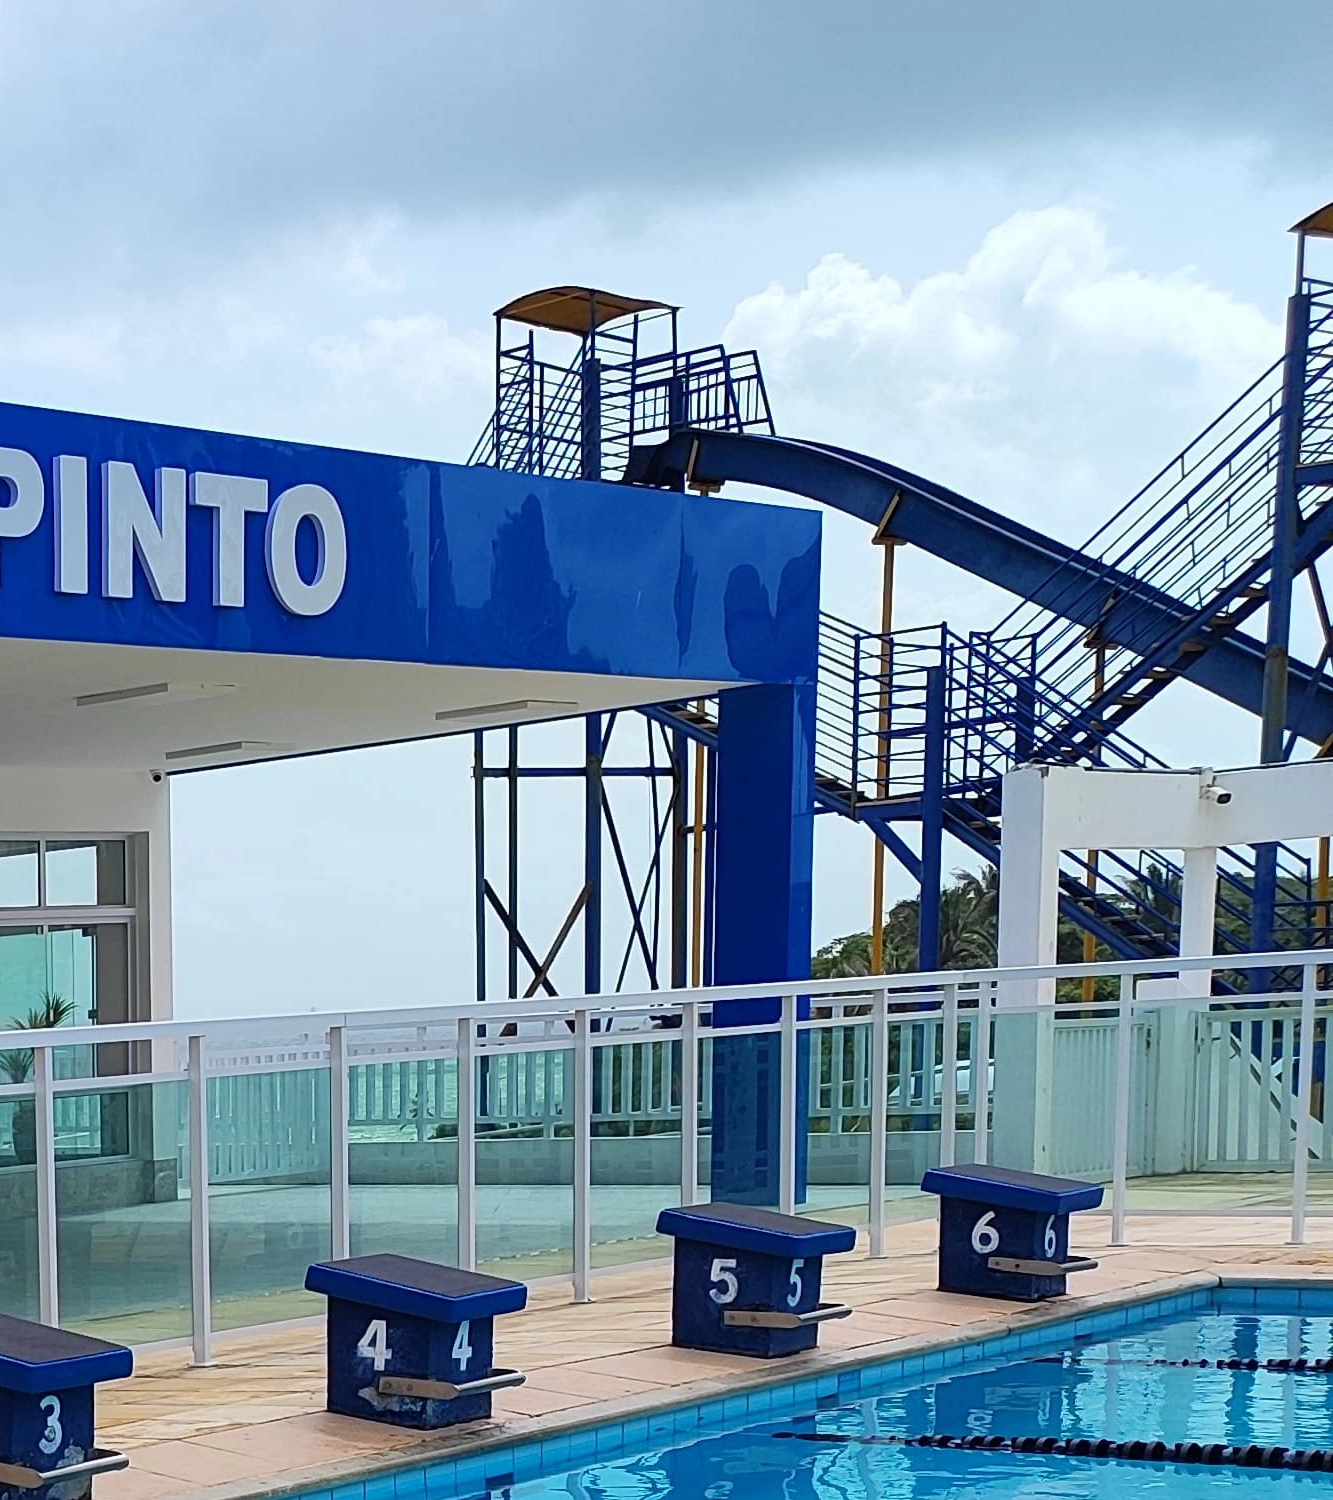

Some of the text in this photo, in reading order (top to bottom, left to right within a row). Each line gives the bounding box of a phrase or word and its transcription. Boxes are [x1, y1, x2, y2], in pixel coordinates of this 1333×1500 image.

[971, 1210, 1000, 1255] 6
[1044, 1214, 1056, 1258] 6
[708, 1258, 739, 1304] 5
[786, 1258, 805, 1307] 5
[356, 1319, 393, 1372] 4
[451, 1319, 473, 1372] 4
[38, 1394, 63, 1455] 3
